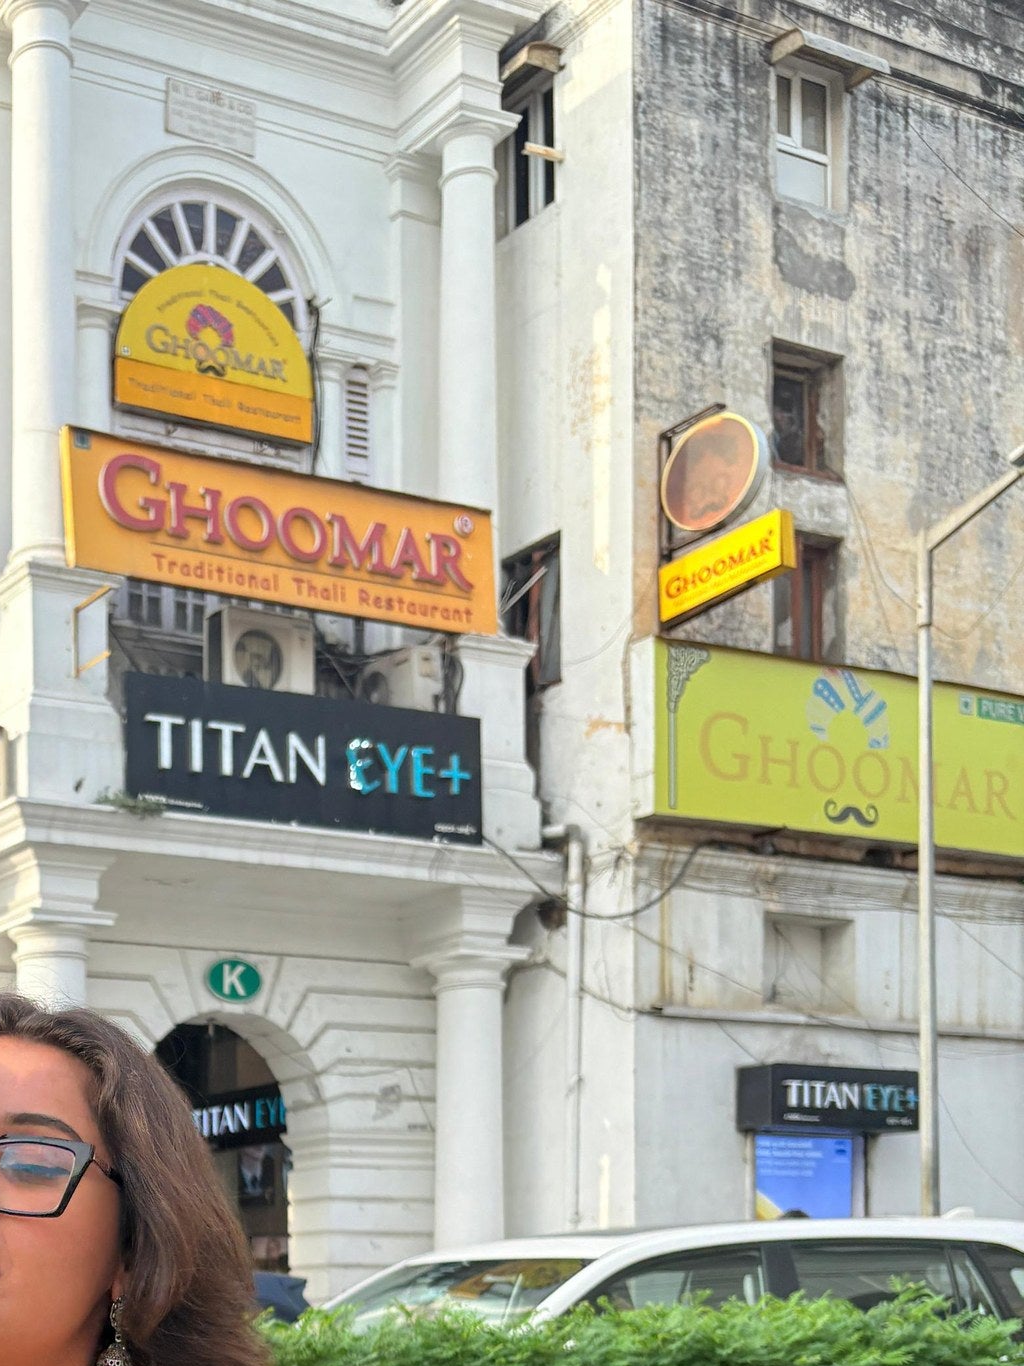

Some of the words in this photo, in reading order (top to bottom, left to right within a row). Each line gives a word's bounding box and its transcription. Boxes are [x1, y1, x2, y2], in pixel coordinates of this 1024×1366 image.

[144, 323, 288, 383] GHOOMAR
[97, 453, 475, 593] GHOOMAR
[151, 552, 280, 592] Traditional
[290, 576, 347, 604] Thali
[358, 588, 475, 624] Restaurant
[664, 537, 775, 600] GHOOMAR
[143, 712, 327, 787] TITAN
[345, 738, 472, 799] EYE+
[222, 963, 247, 997] K
[782, 1079, 860, 1111] TITAN
[863, 1083, 919, 1112] EYE+
